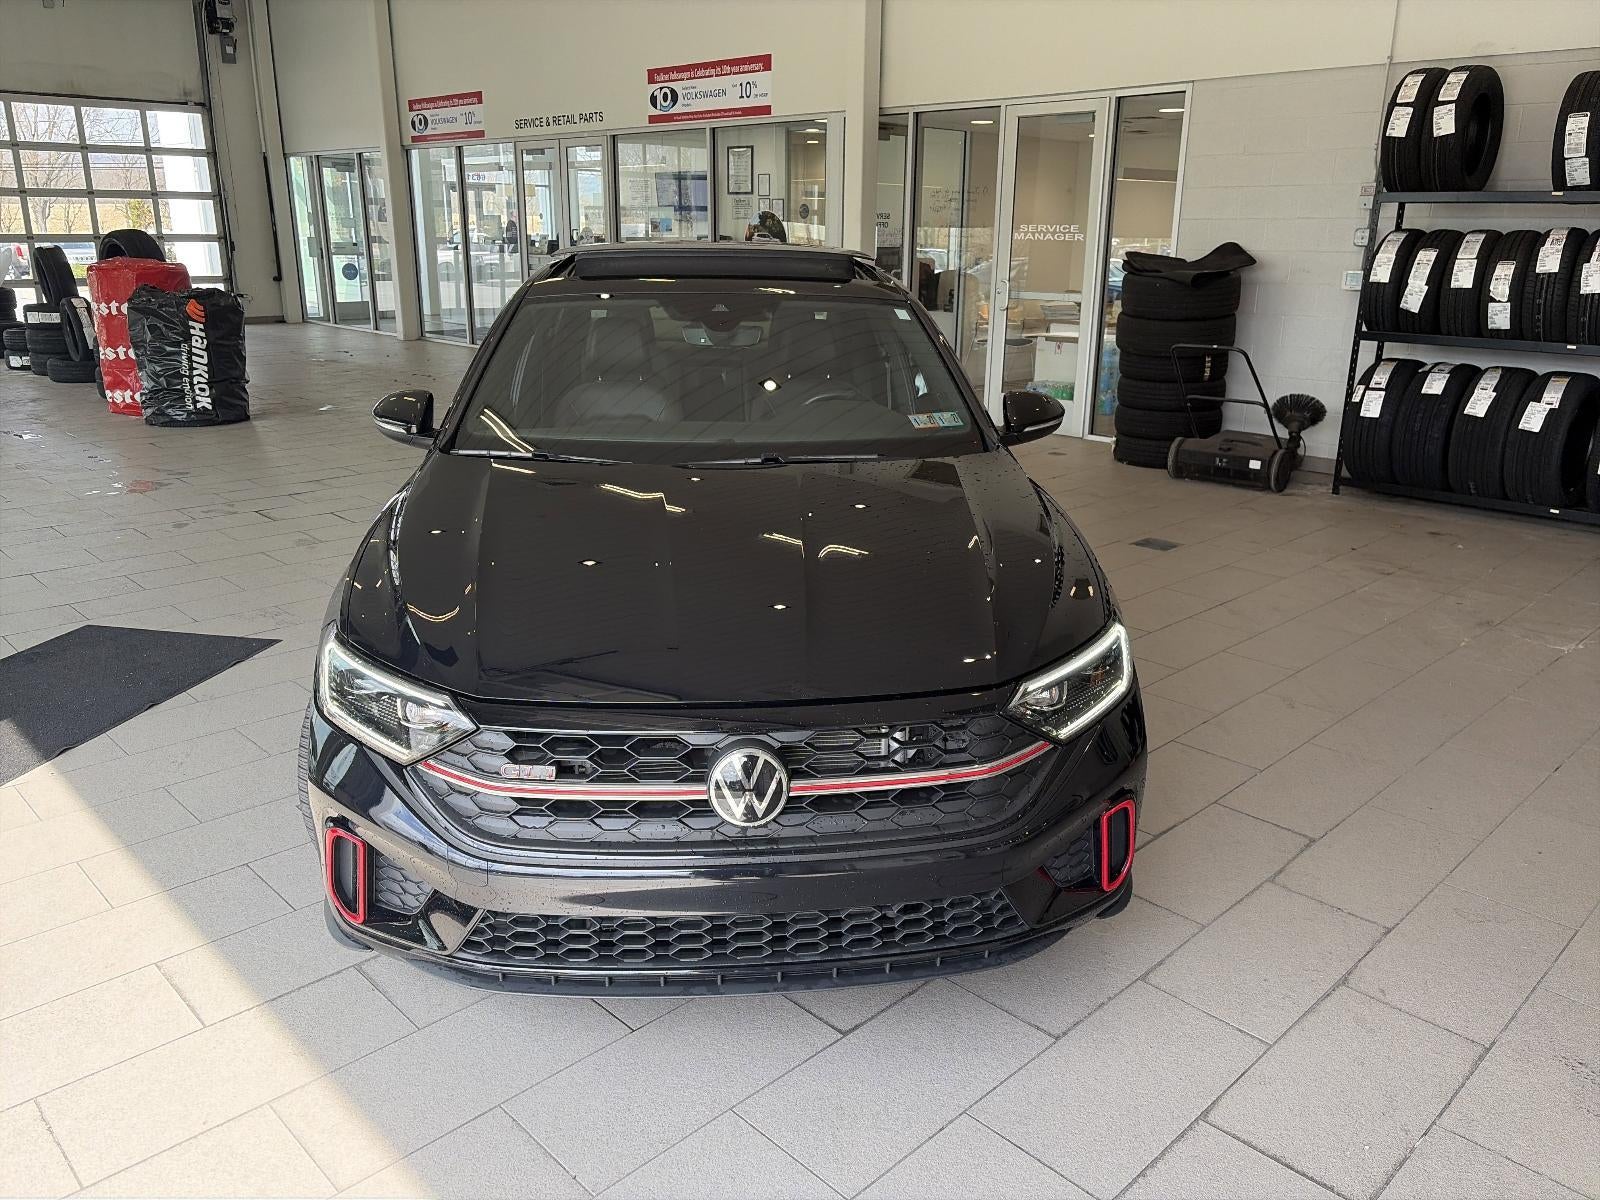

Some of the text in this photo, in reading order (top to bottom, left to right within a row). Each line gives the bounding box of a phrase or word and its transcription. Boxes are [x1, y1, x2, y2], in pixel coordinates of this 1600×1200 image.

[670, 70, 690, 81] Volkswagen
[695, 66, 715, 78] Celebrating
[731, 65, 739, 75] year
[681, 88, 726, 101] VOLKSWAGEN
[430, 117, 458, 126] VOLKSWAGEN
[514, 111, 604, 129] SERVICE & RETAIL PARTS
[1019, 224, 1080, 233] SERVICE
[1014, 232, 1085, 241] MANAGER
[180, 343, 190, 376] driving
